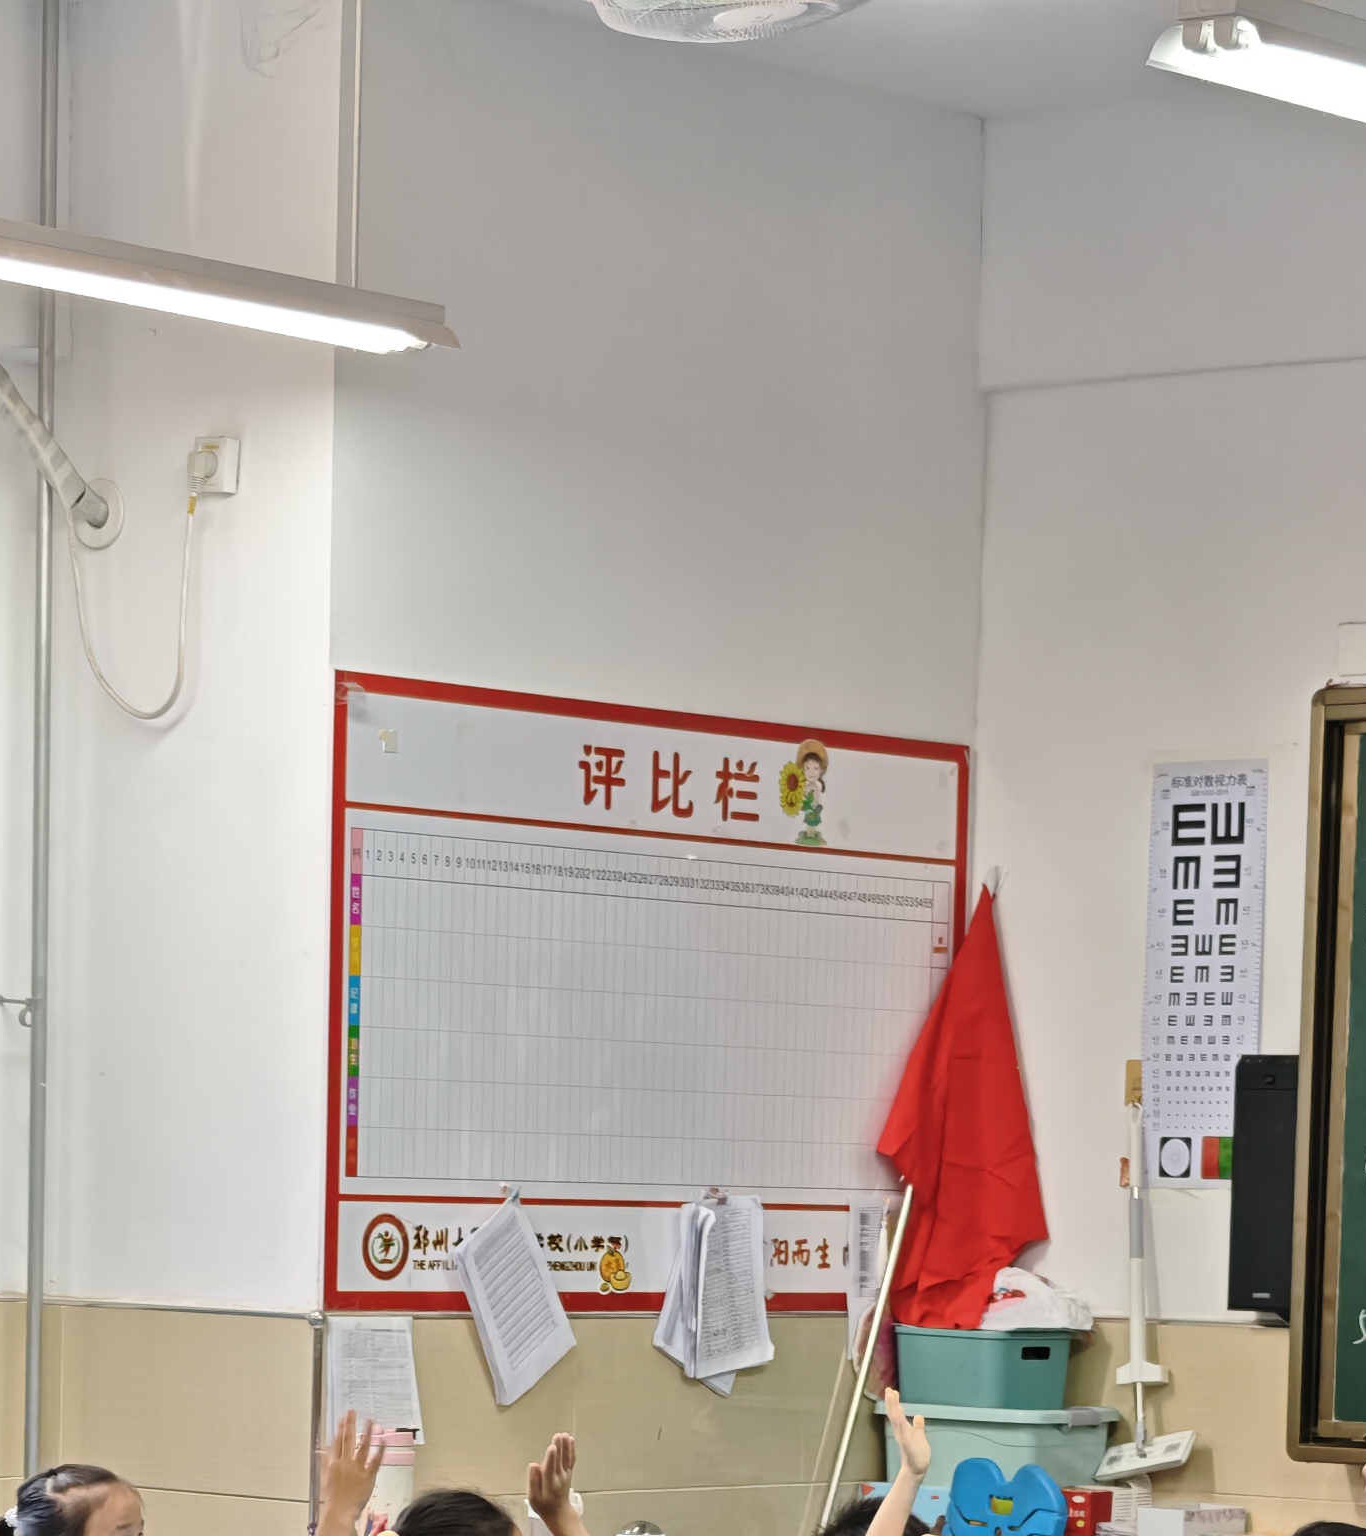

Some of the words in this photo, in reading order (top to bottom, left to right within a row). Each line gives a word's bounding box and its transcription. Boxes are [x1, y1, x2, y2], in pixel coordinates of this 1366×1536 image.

[579, 743, 760, 822] 评比栏
[364, 849, 371, 860] 1
[376, 850, 382, 861] 2
[387, 851, 394, 862] 3
[399, 852, 405, 863] 4
[410, 853, 417, 864] 5
[421, 854, 428, 865] 6
[433, 855, 439, 866] 7
[444, 856, 451, 867] 8
[455, 857, 462, 868] 9
